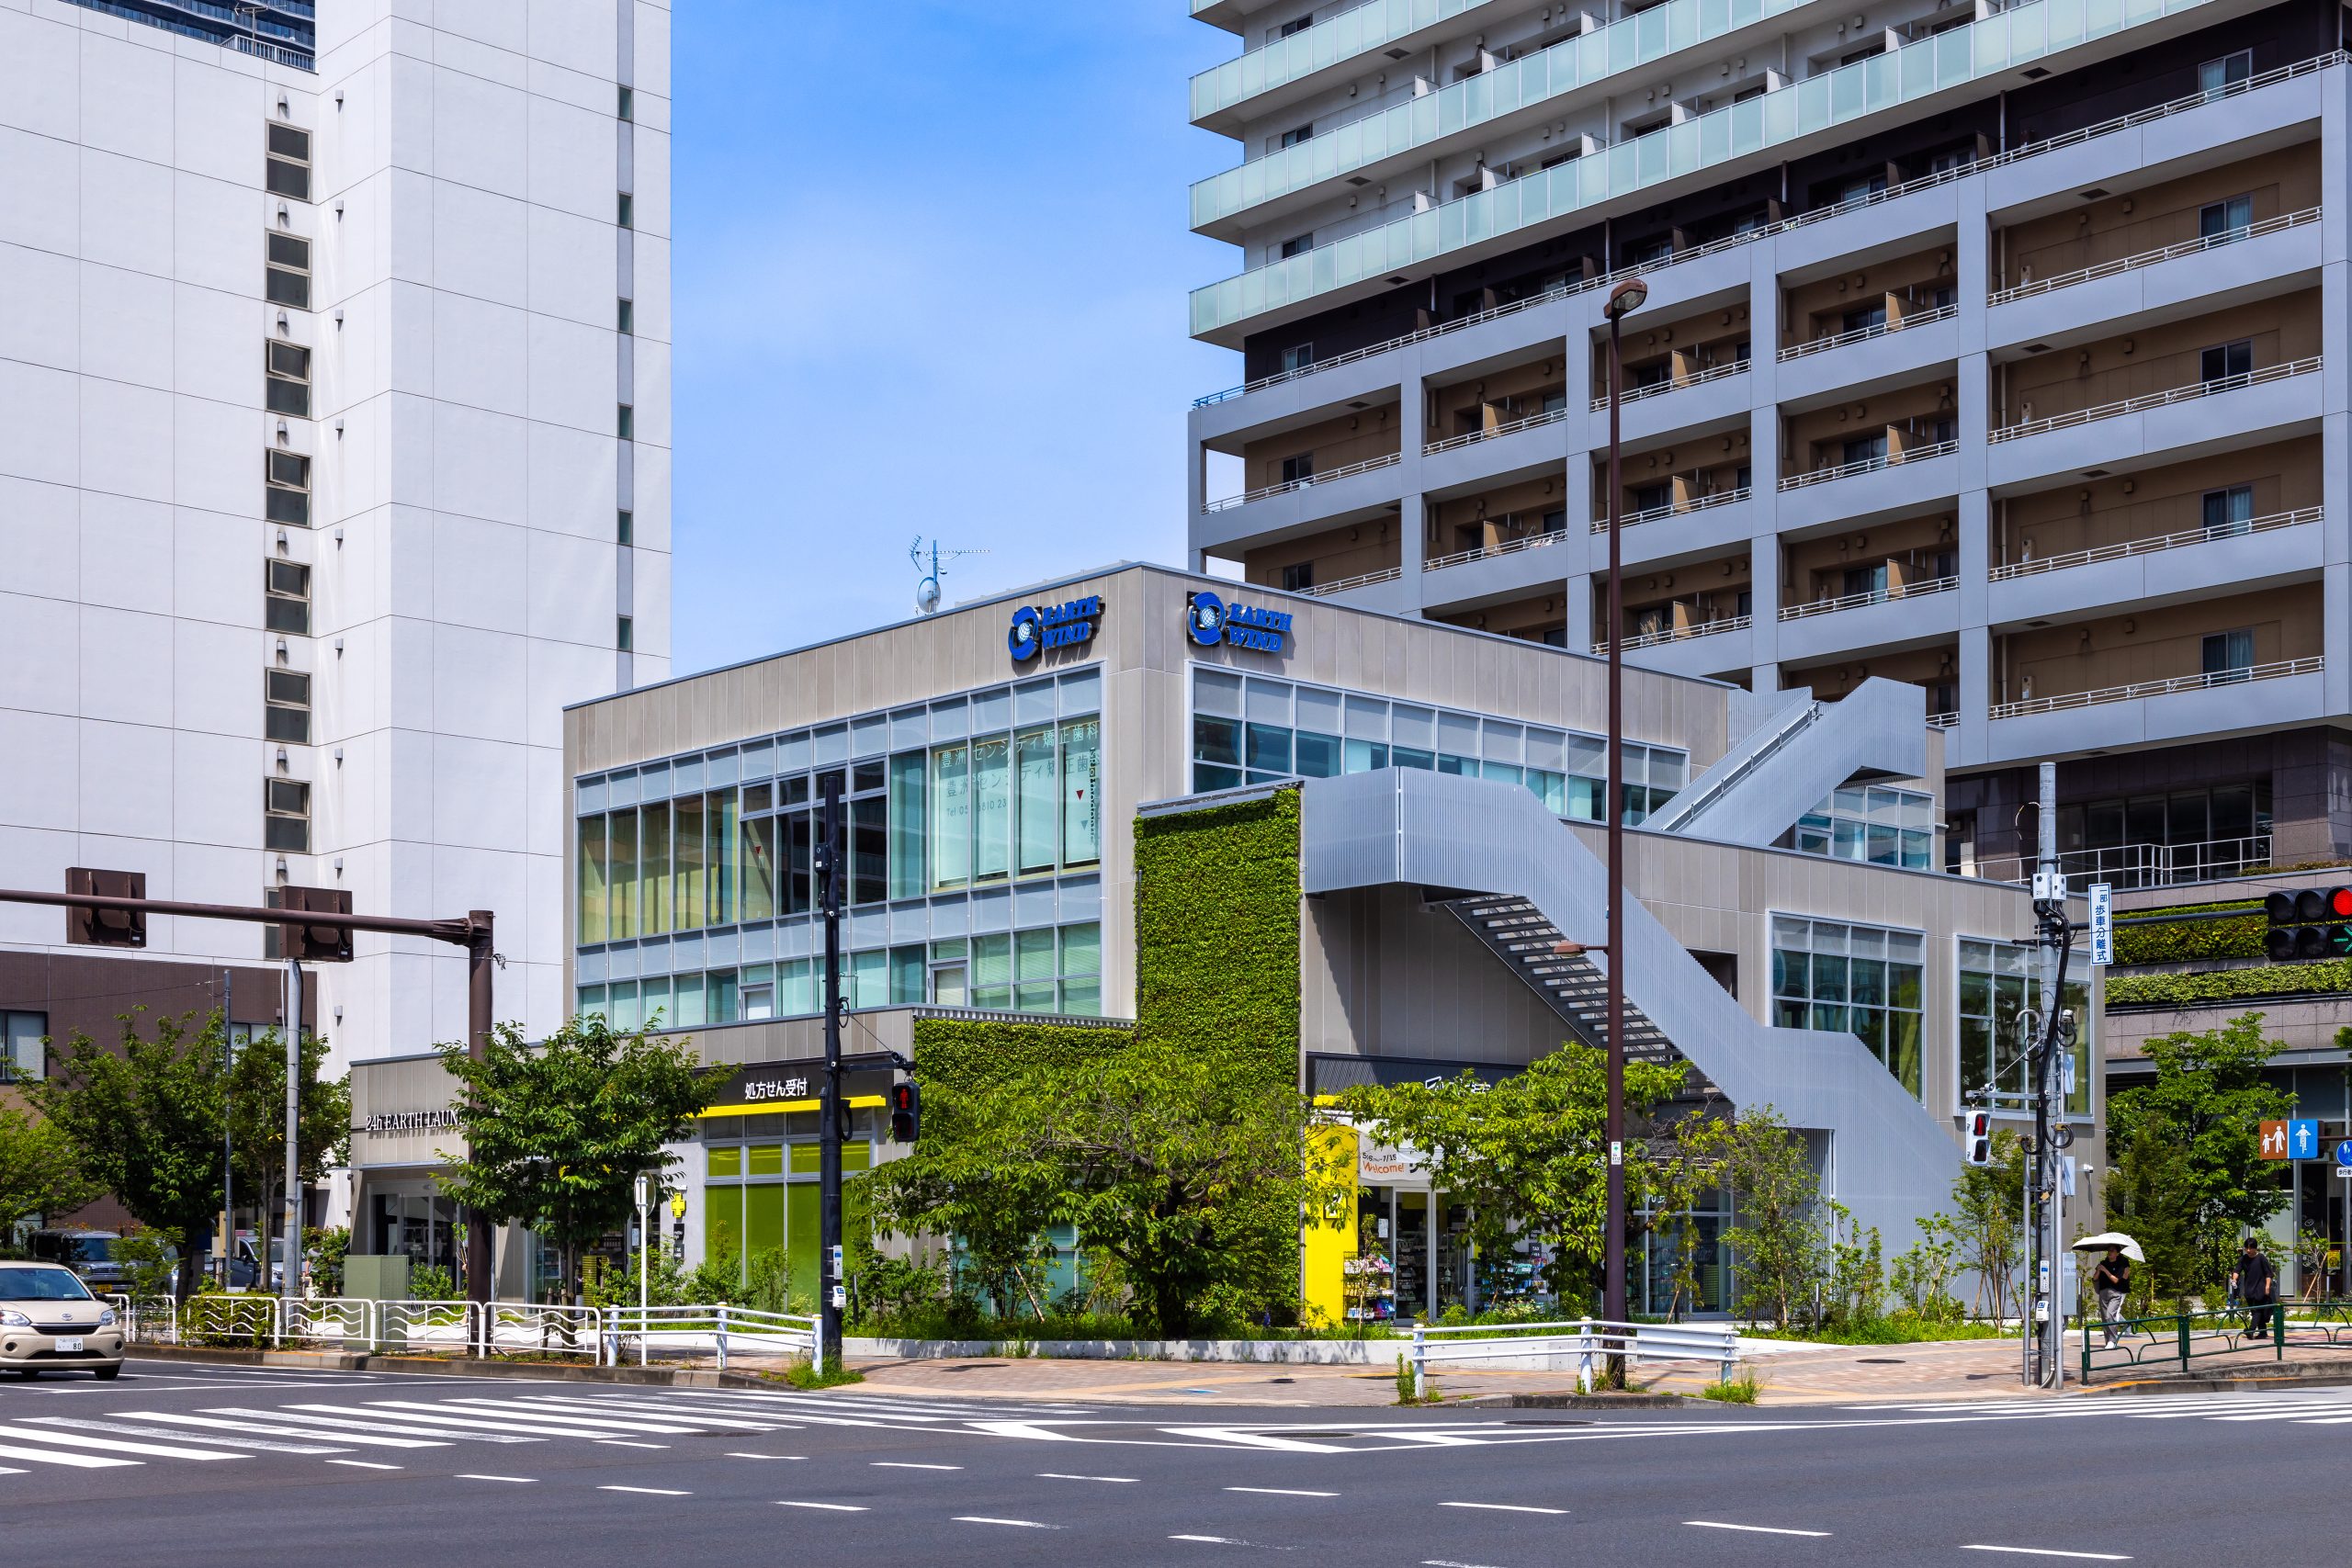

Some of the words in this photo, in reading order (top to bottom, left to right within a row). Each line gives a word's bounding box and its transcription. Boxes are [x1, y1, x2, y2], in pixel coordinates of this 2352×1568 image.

[1042, 594, 1101, 625] EARTH
[1228, 603, 1293, 632] EARTH
[1041, 621, 1092, 649] WIND
[1227, 626, 1283, 652] WIND
[745, 1077, 808, 1100] 処方せん受付
[366, 1114, 383, 1131] 24h
[385, 1111, 424, 1131] EARTH
[426, 1109, 465, 1128] LAUN
[1363, 1161, 1405, 1174] Welcome!
